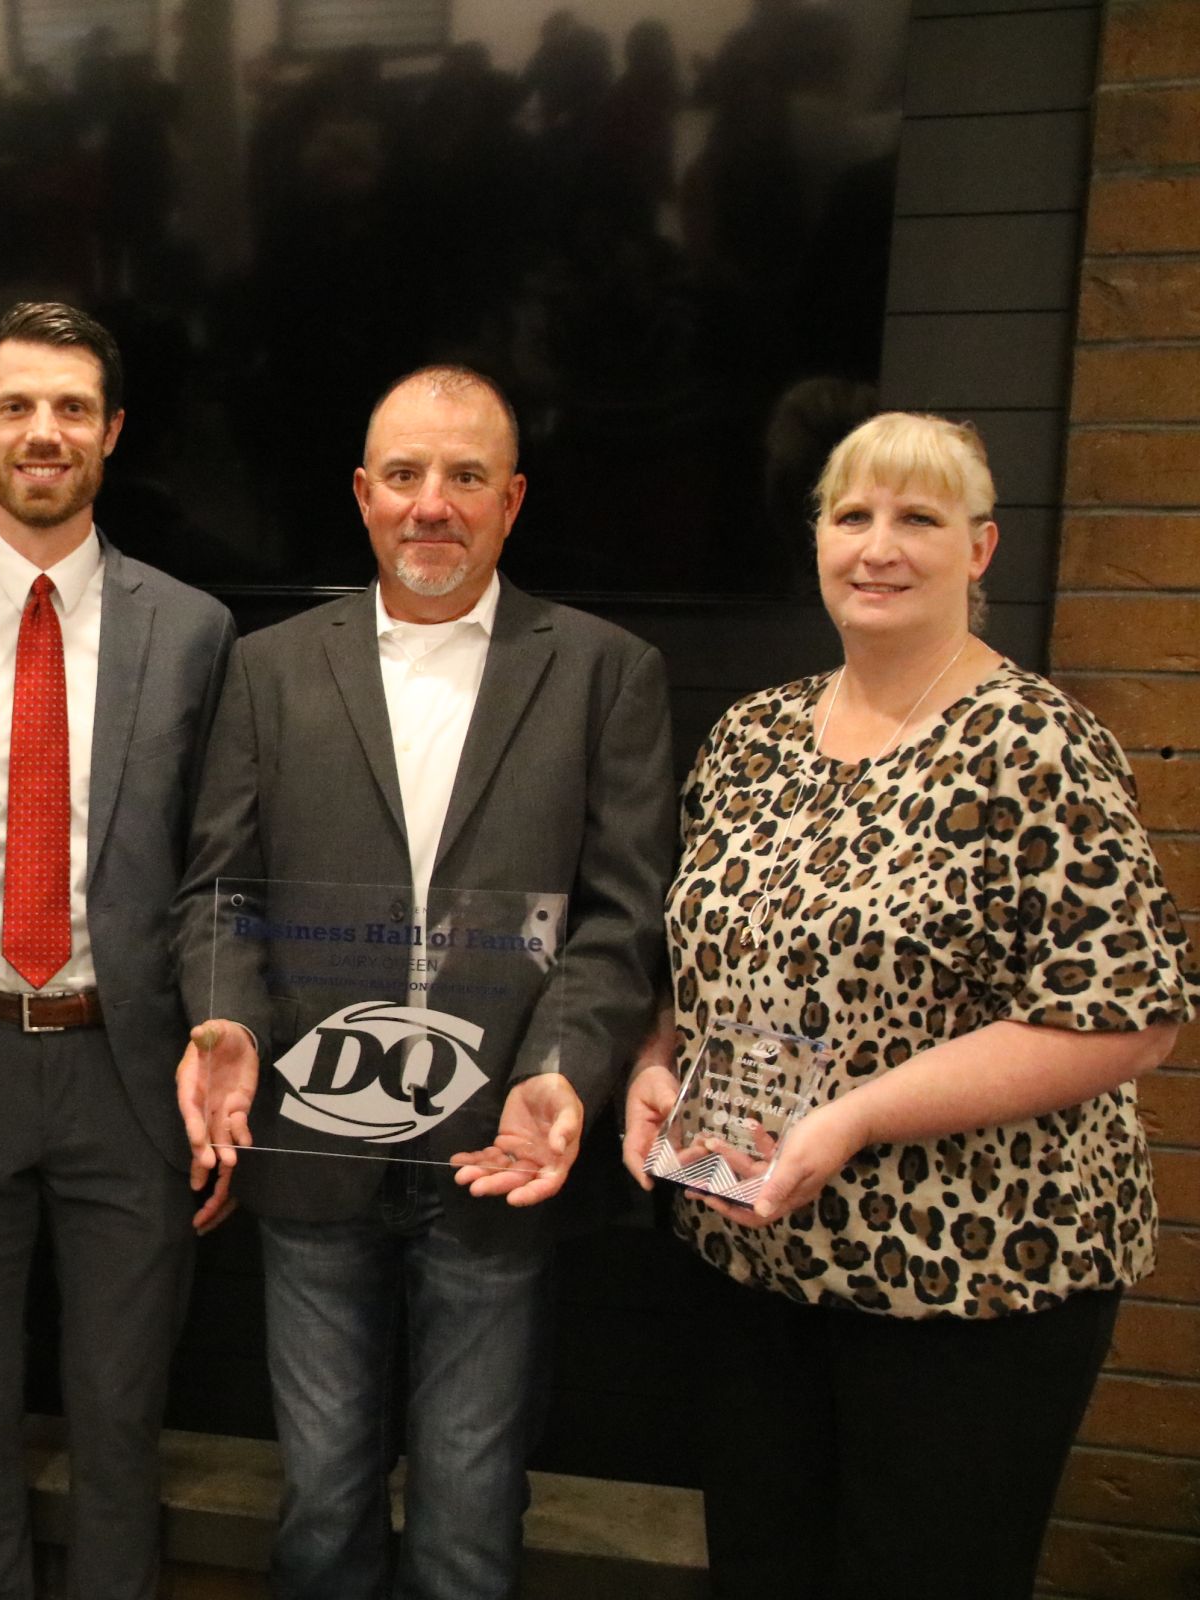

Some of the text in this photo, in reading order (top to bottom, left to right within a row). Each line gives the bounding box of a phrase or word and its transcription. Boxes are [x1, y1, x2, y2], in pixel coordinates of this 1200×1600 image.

[233, 916, 543, 952] Business Hall of Fame
[300, 1026, 458, 1117] DQ
[703, 1088, 786, 1117] HALL OF FAME
